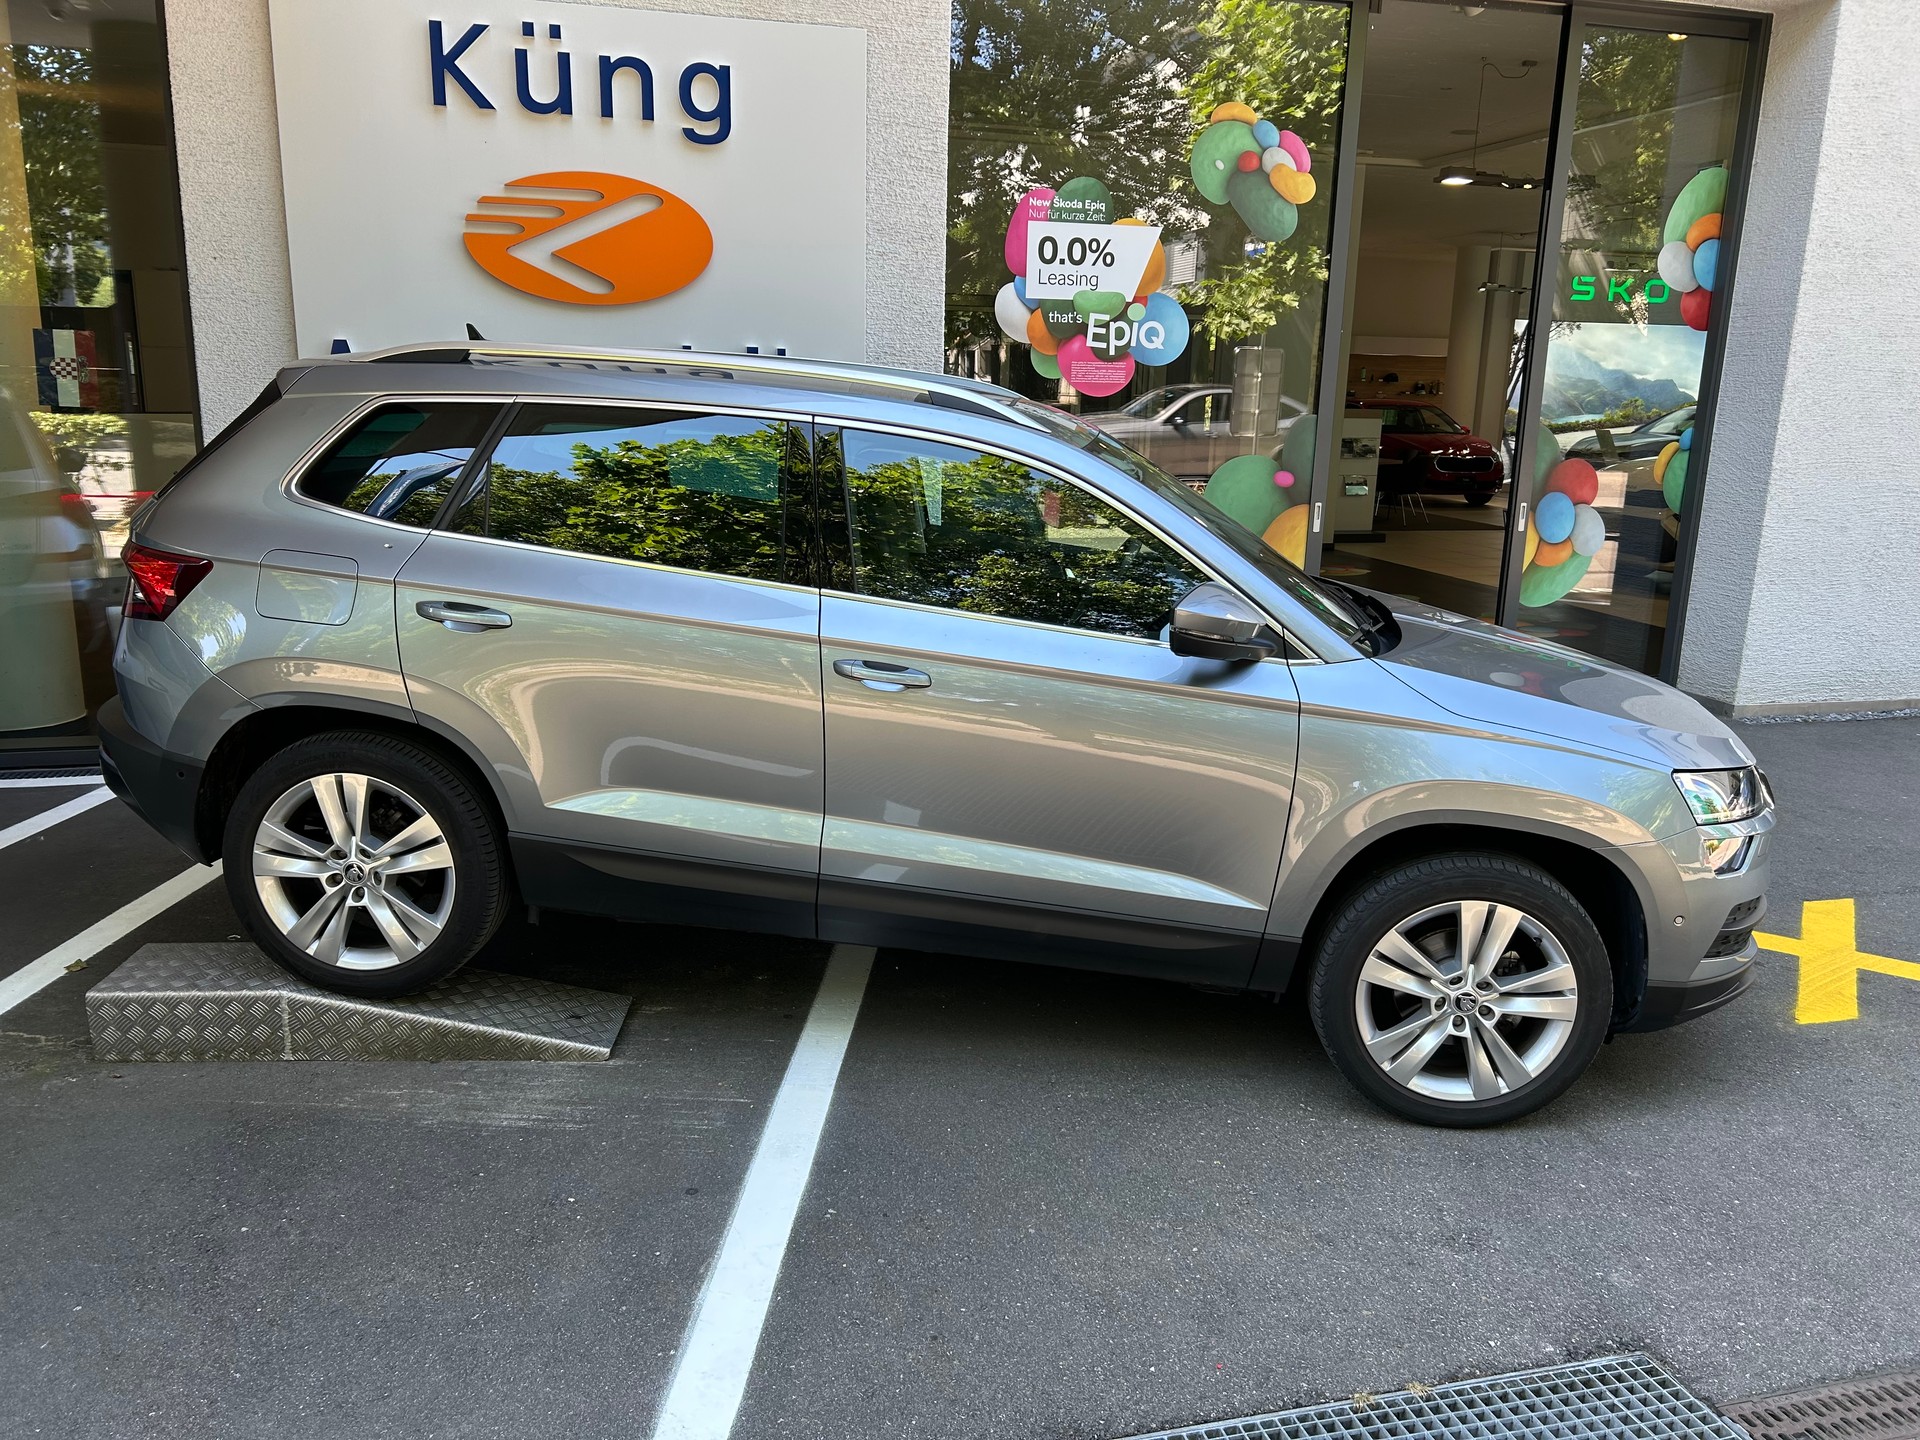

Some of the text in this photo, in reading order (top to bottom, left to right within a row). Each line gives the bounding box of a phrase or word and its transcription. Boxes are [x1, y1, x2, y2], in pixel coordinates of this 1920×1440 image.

[428, 20, 732, 145] Küng
[1029, 195, 1106, 212] New Škoda Epiq
[1028, 208, 1106, 222] Nur für kurze Zeit:
[1038, 236, 1115, 267] 0.0%
[1038, 268, 1099, 291] Leasing
[1048, 311, 1083, 324] that’s
